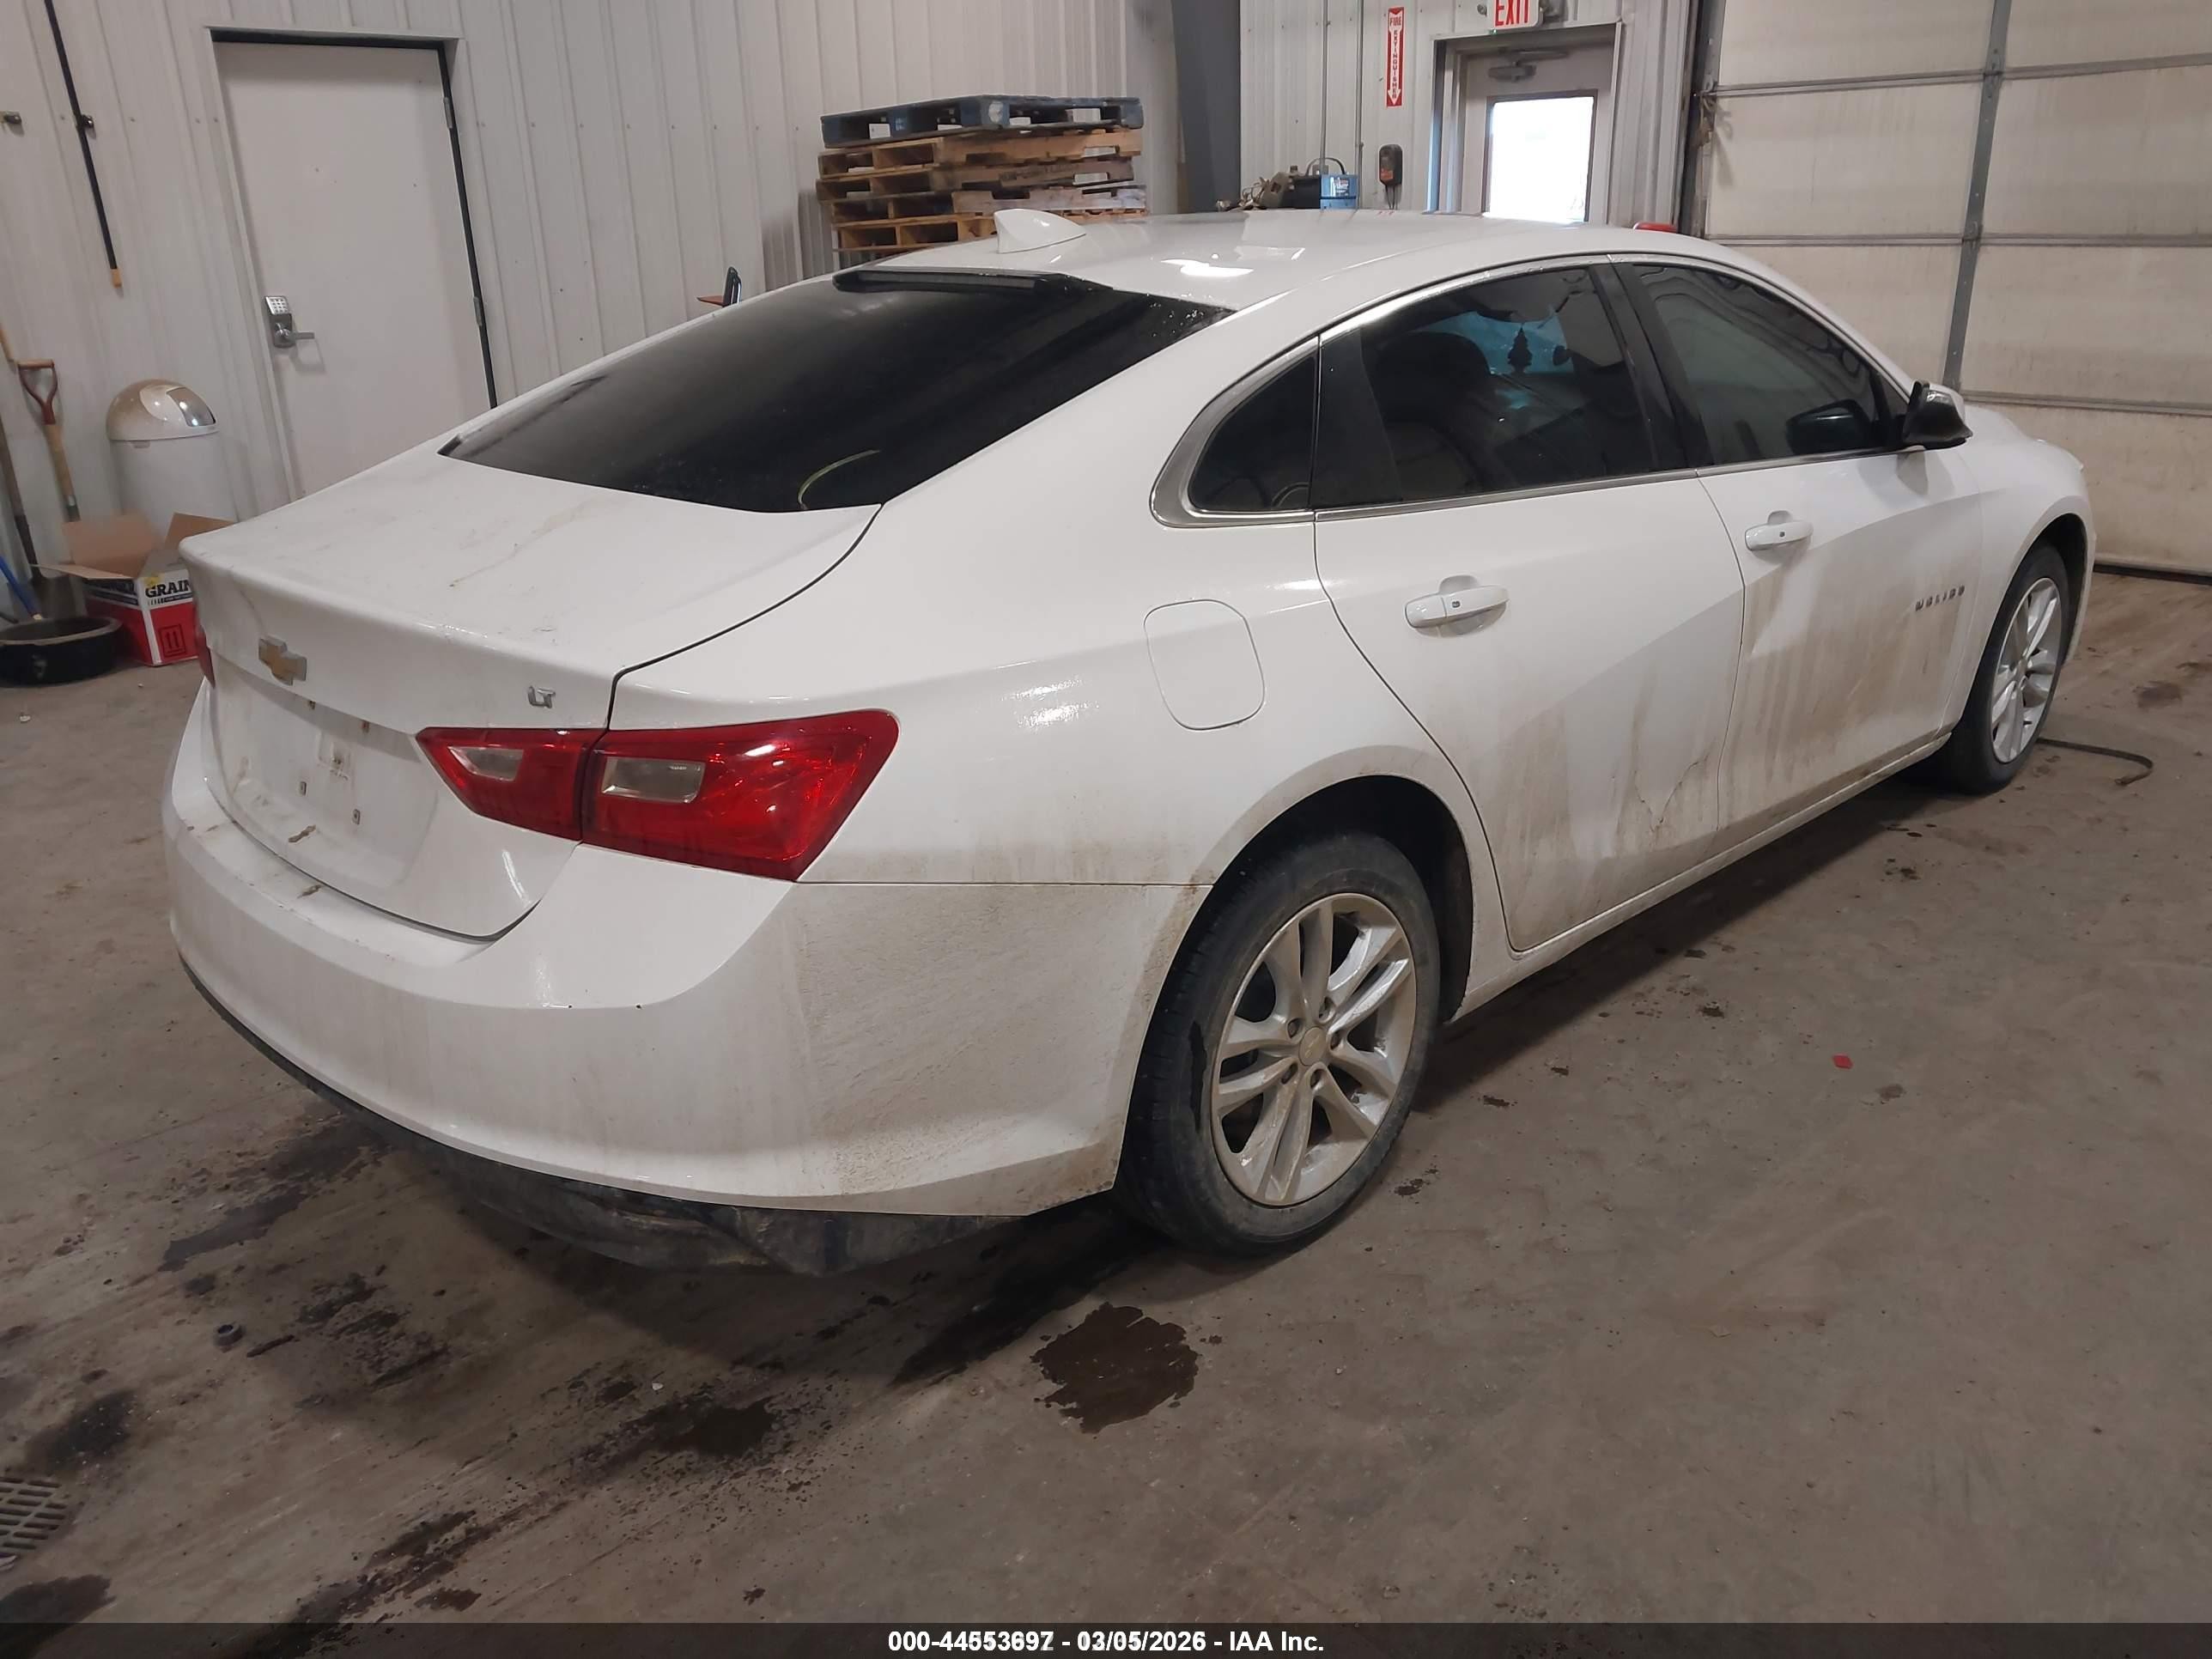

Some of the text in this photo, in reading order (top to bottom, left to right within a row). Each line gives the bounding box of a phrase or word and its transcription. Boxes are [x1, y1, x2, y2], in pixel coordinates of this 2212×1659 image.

[1389, 16, 1401, 27] FIRE
[1495, 0, 1528, 26] EXIT
[527, 685, 556, 708] LT
